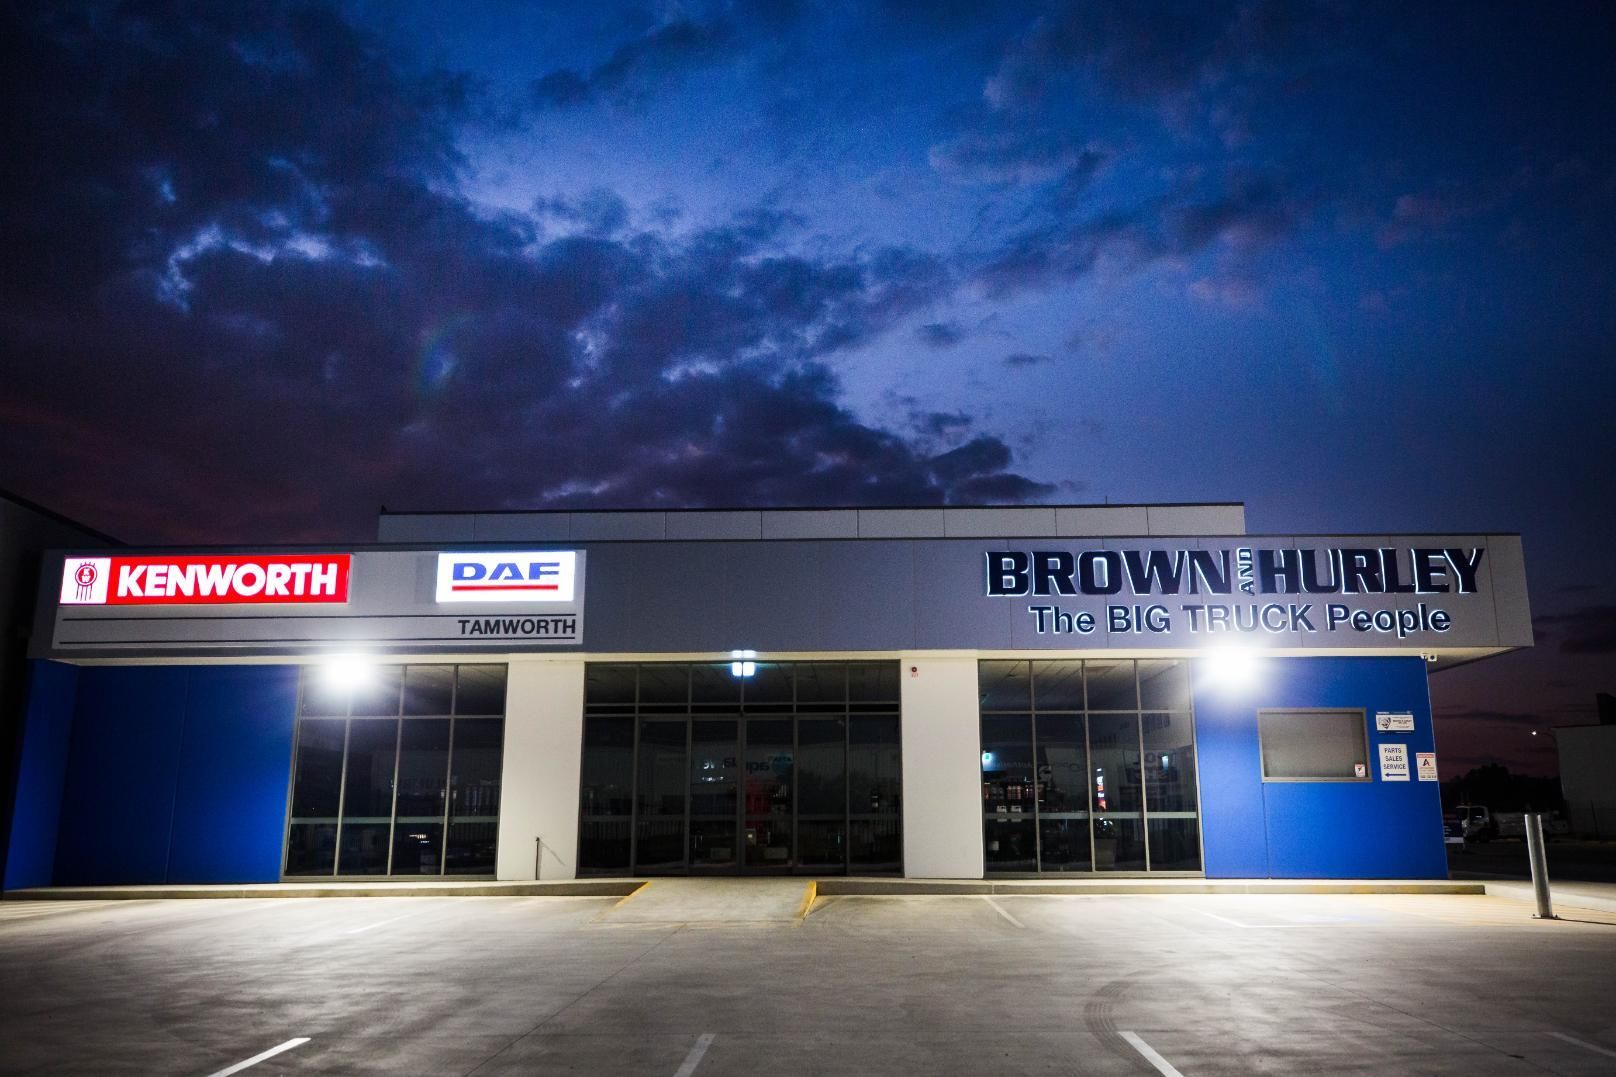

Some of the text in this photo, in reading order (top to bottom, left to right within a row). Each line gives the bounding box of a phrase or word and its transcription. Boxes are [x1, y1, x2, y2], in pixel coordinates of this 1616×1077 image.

[117, 563, 337, 597] KENWORTH
[452, 562, 560, 580] DAF
[986, 551, 1232, 596] BROWN
[1236, 547, 1254, 595] AND
[1259, 548, 1484, 594] HURLEY
[458, 619, 576, 635] TAMWORTH
[1028, 604, 1451, 638] The BIG TRUCK People
